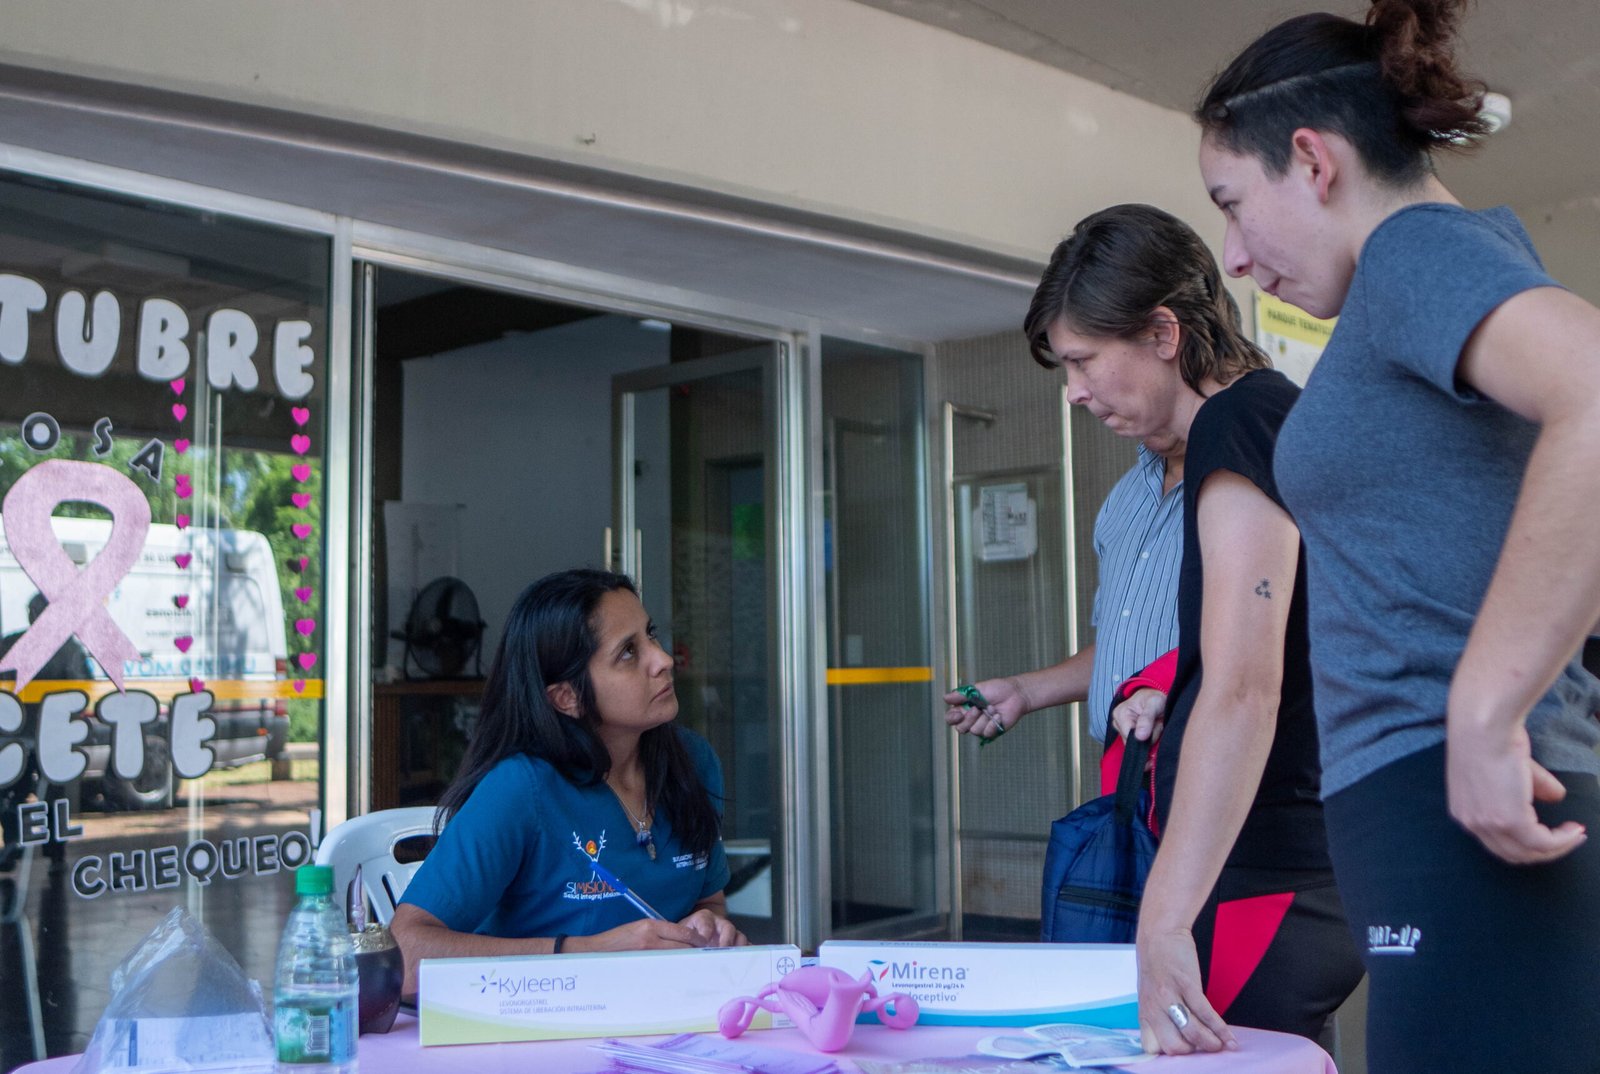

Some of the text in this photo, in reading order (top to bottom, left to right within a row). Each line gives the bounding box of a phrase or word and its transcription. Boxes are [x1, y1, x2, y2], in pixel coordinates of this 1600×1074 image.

[0, 273, 315, 399] TUBRE
[18, 798, 84, 847] EL
[892, 961, 967, 980] Mirena
[499, 976, 576, 998] Kyleena
[892, 982, 934, 990] Levonorgestrel
